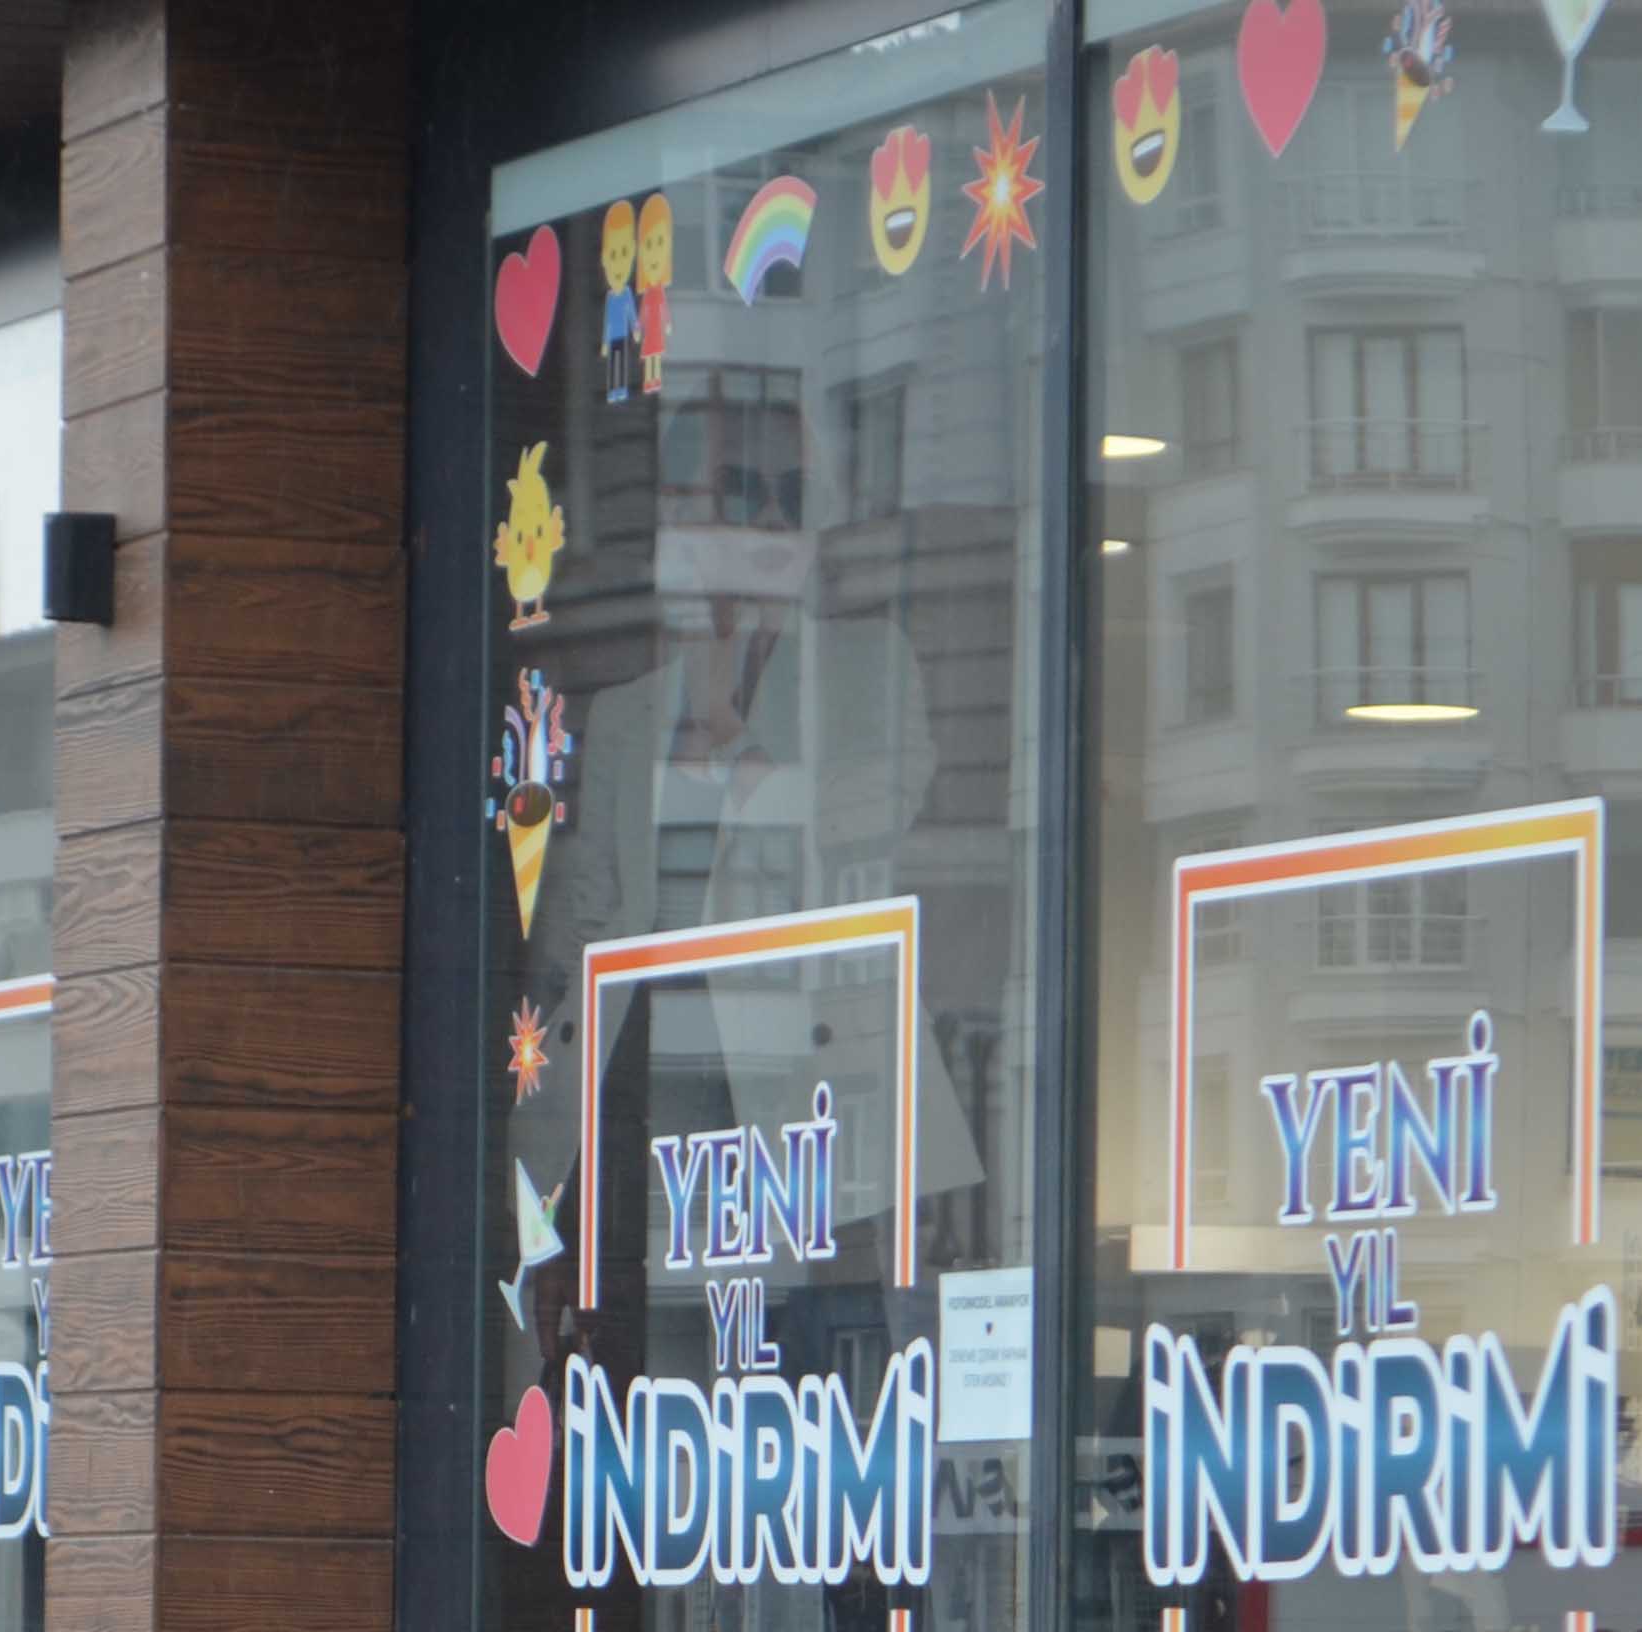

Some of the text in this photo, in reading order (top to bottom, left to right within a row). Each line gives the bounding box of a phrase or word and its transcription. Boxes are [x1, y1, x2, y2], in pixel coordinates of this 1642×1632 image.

[652, 1080, 836, 1269] YENİ
[1260, 1009, 1499, 1225] YENİ
[707, 1277, 779, 1370] YIL
[1324, 1226, 1419, 1336] YIL
